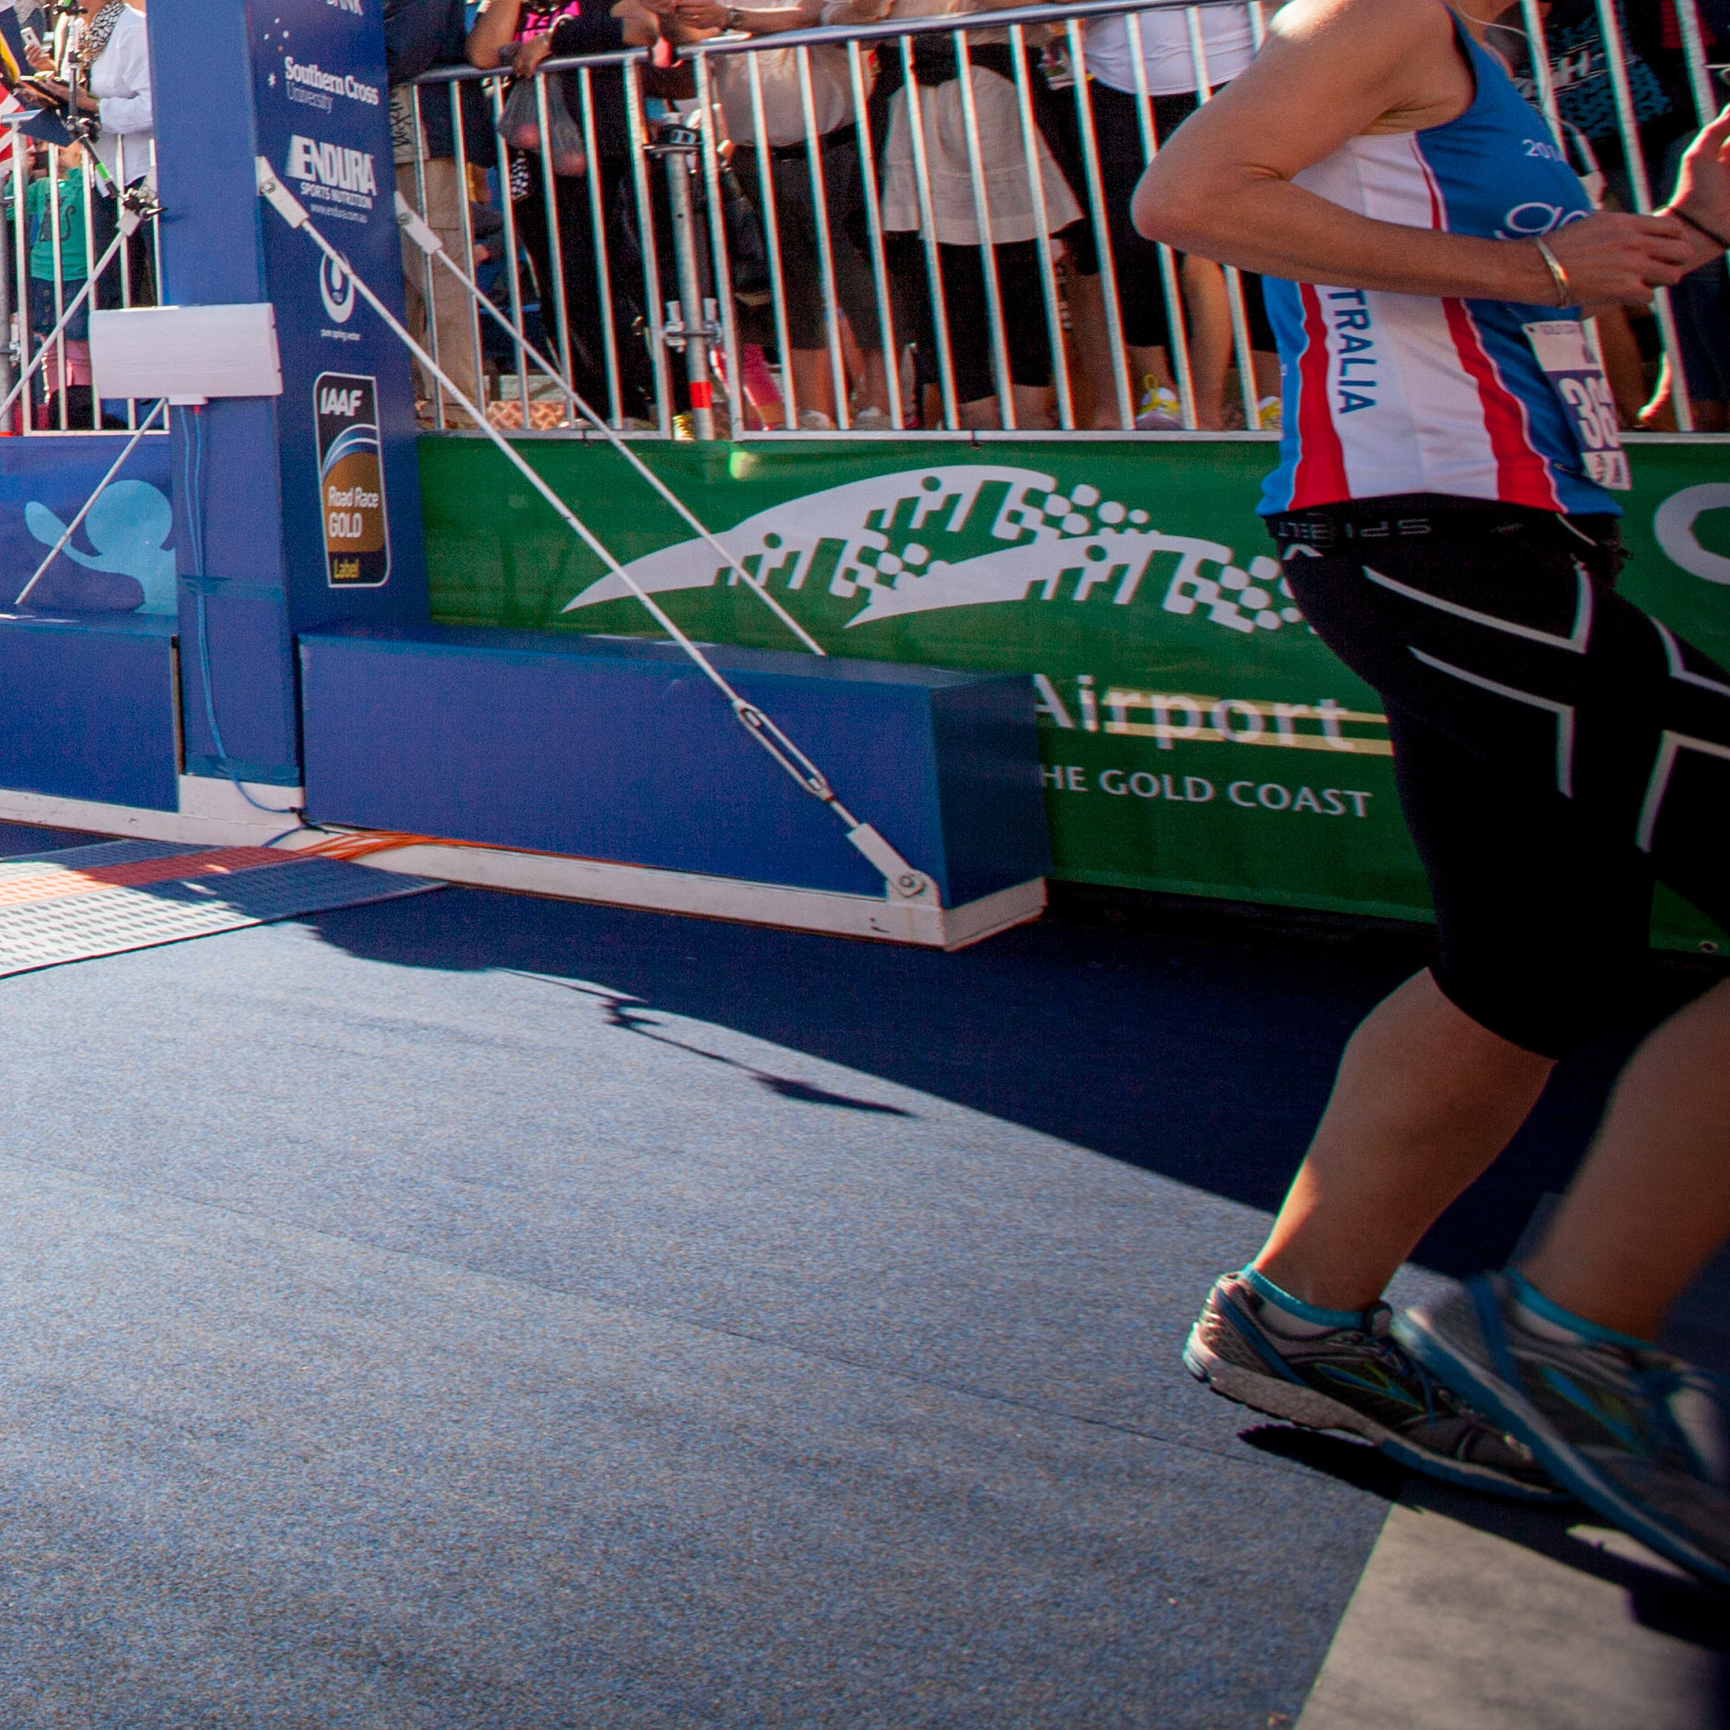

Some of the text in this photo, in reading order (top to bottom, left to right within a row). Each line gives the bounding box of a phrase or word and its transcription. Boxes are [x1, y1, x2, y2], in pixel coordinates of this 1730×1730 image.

[284, 56, 380, 106] Southern Cross
[285, 134, 378, 197] ENDURA
[1327, 287, 1377, 415] TRALIA
[320, 387, 363, 417] IAAF
[328, 486, 380, 508] Road Race
[329, 512, 362, 538] GOLD
[1032, 673, 1355, 750] Airport
[1098, 768, 1216, 803] GOLD
[1226, 780, 1373, 818] COAST
